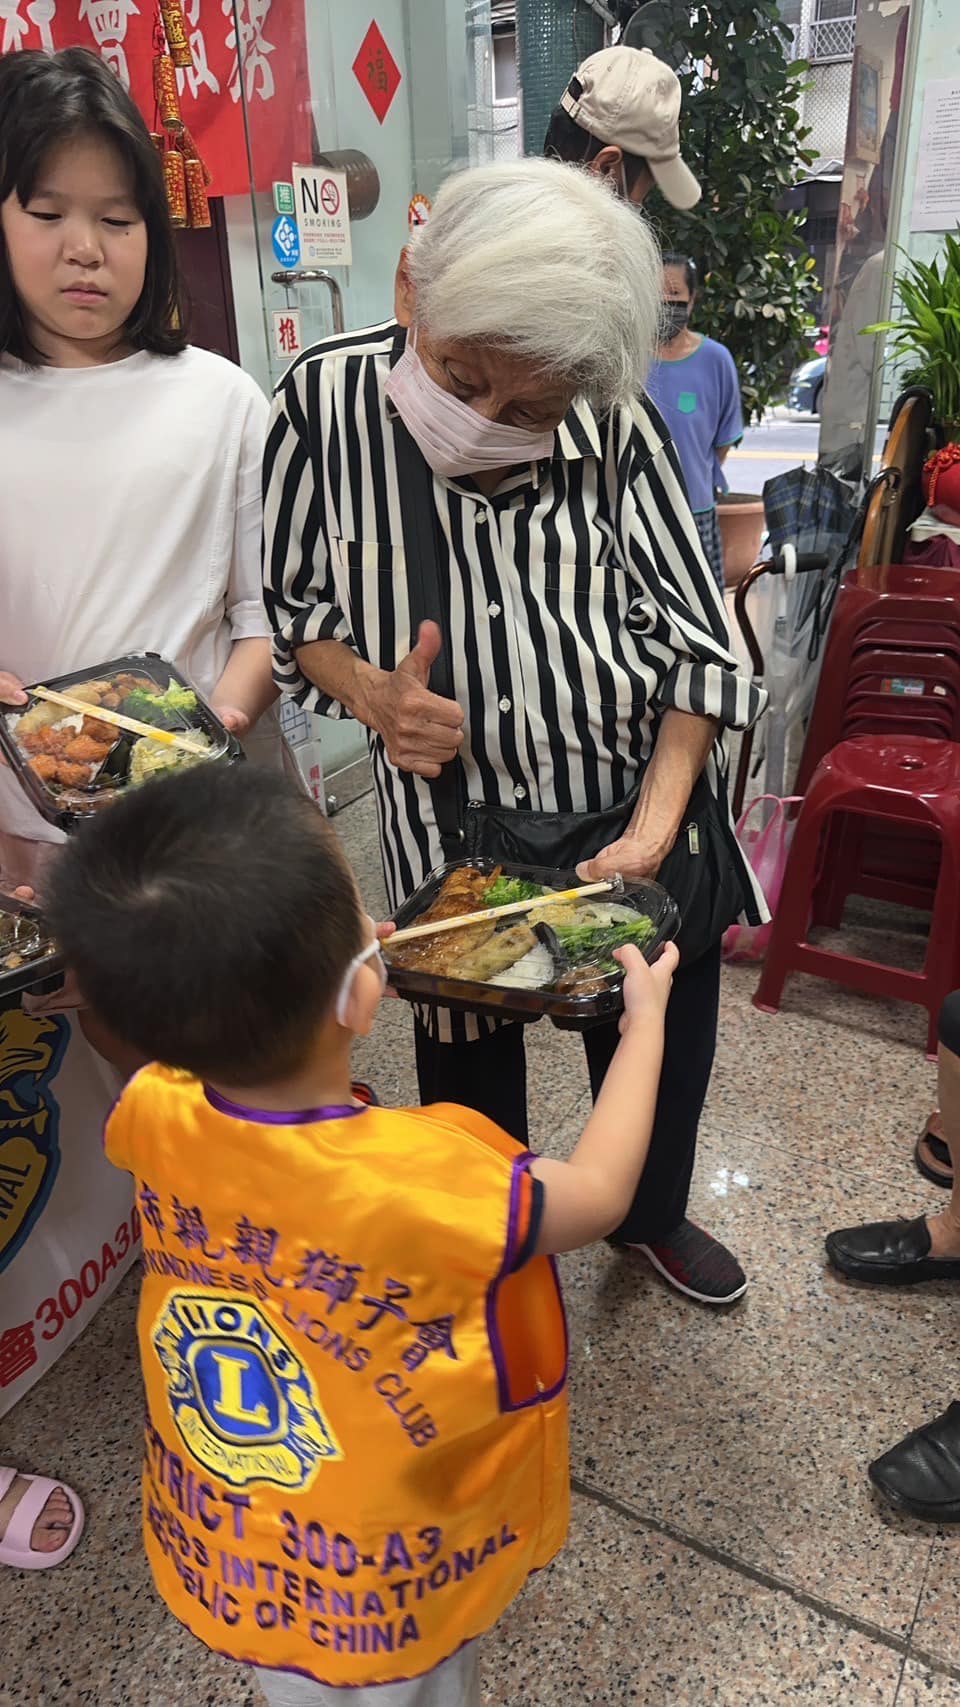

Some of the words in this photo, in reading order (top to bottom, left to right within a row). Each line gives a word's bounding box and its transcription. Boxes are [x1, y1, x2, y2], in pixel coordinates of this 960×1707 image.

[304, 218, 342, 228] SMOKING
[279, 317, 299, 354] 推
[182, 1304, 292, 1371] LIONS
[211, 1350, 272, 1429] L
[282, 1299, 372, 1371] LIONS
[373, 1372, 440, 1448] CLUB
[221, 1523, 519, 1618] INTERNATIONAL
[279, 1510, 443, 1578] 300-A3
[255, 1600, 297, 1630] OF
[309, 1614, 420, 1654] CHINA
